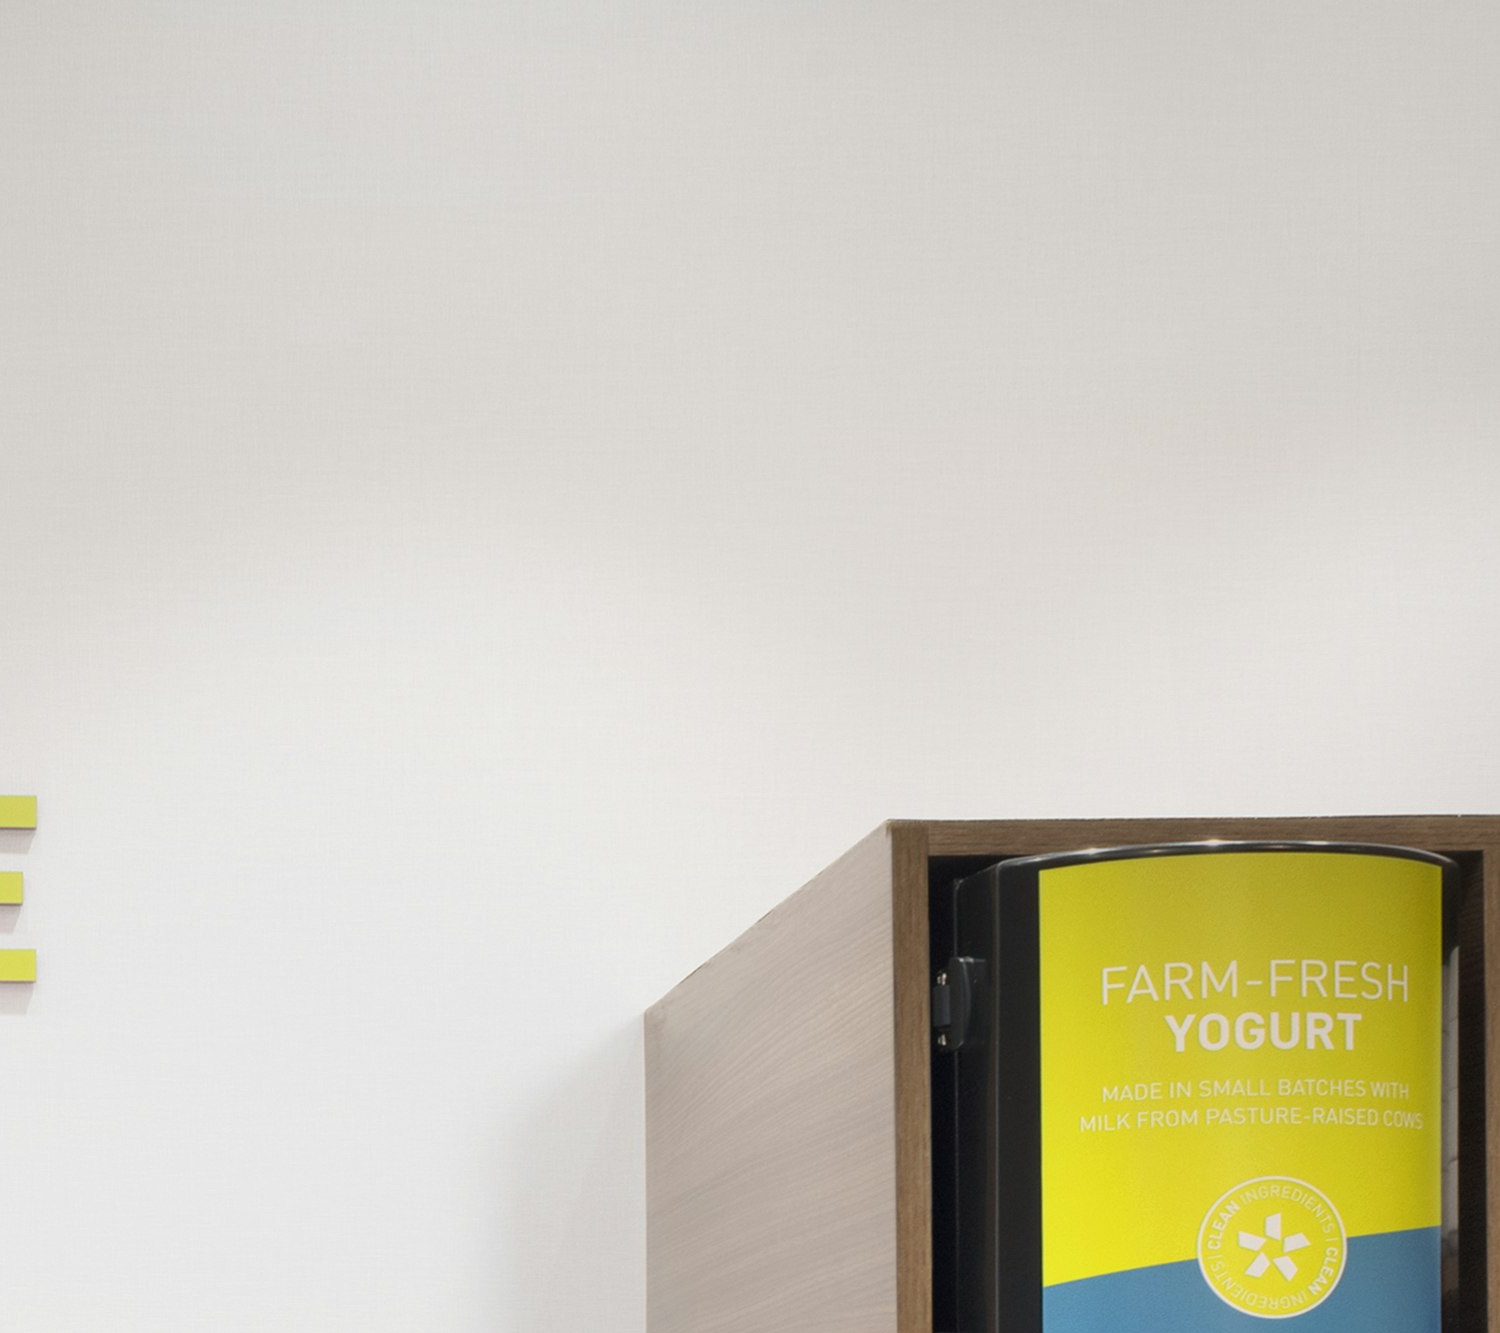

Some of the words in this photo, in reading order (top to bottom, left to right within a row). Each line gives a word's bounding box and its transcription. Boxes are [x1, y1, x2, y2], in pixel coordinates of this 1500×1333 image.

[1102, 960, 1408, 1005] FARM-FRESH
[1164, 1011, 1362, 1052] YOGURT
[1101, 1082, 1162, 1102] MADE
[1169, 1081, 1192, 1098] IN
[1199, 1079, 1271, 1097] SMALL
[1278, 1078, 1366, 1097] BATCHES
[1370, 1081, 1409, 1100] WITH
[1080, 1112, 1130, 1132] MILK
[1136, 1109, 1199, 1129] FROM
[1206, 1107, 1378, 1126] PASTURE-RAISED
[1383, 1110, 1424, 1130] COWS
[1208, 1200, 1240, 1250] CLEAN
[1240, 1185, 1335, 1233] INGREDIENTS
[1210, 1260, 1309, 1310] INGREDIENTS
[1307, 1247, 1338, 1295] CLEAN
